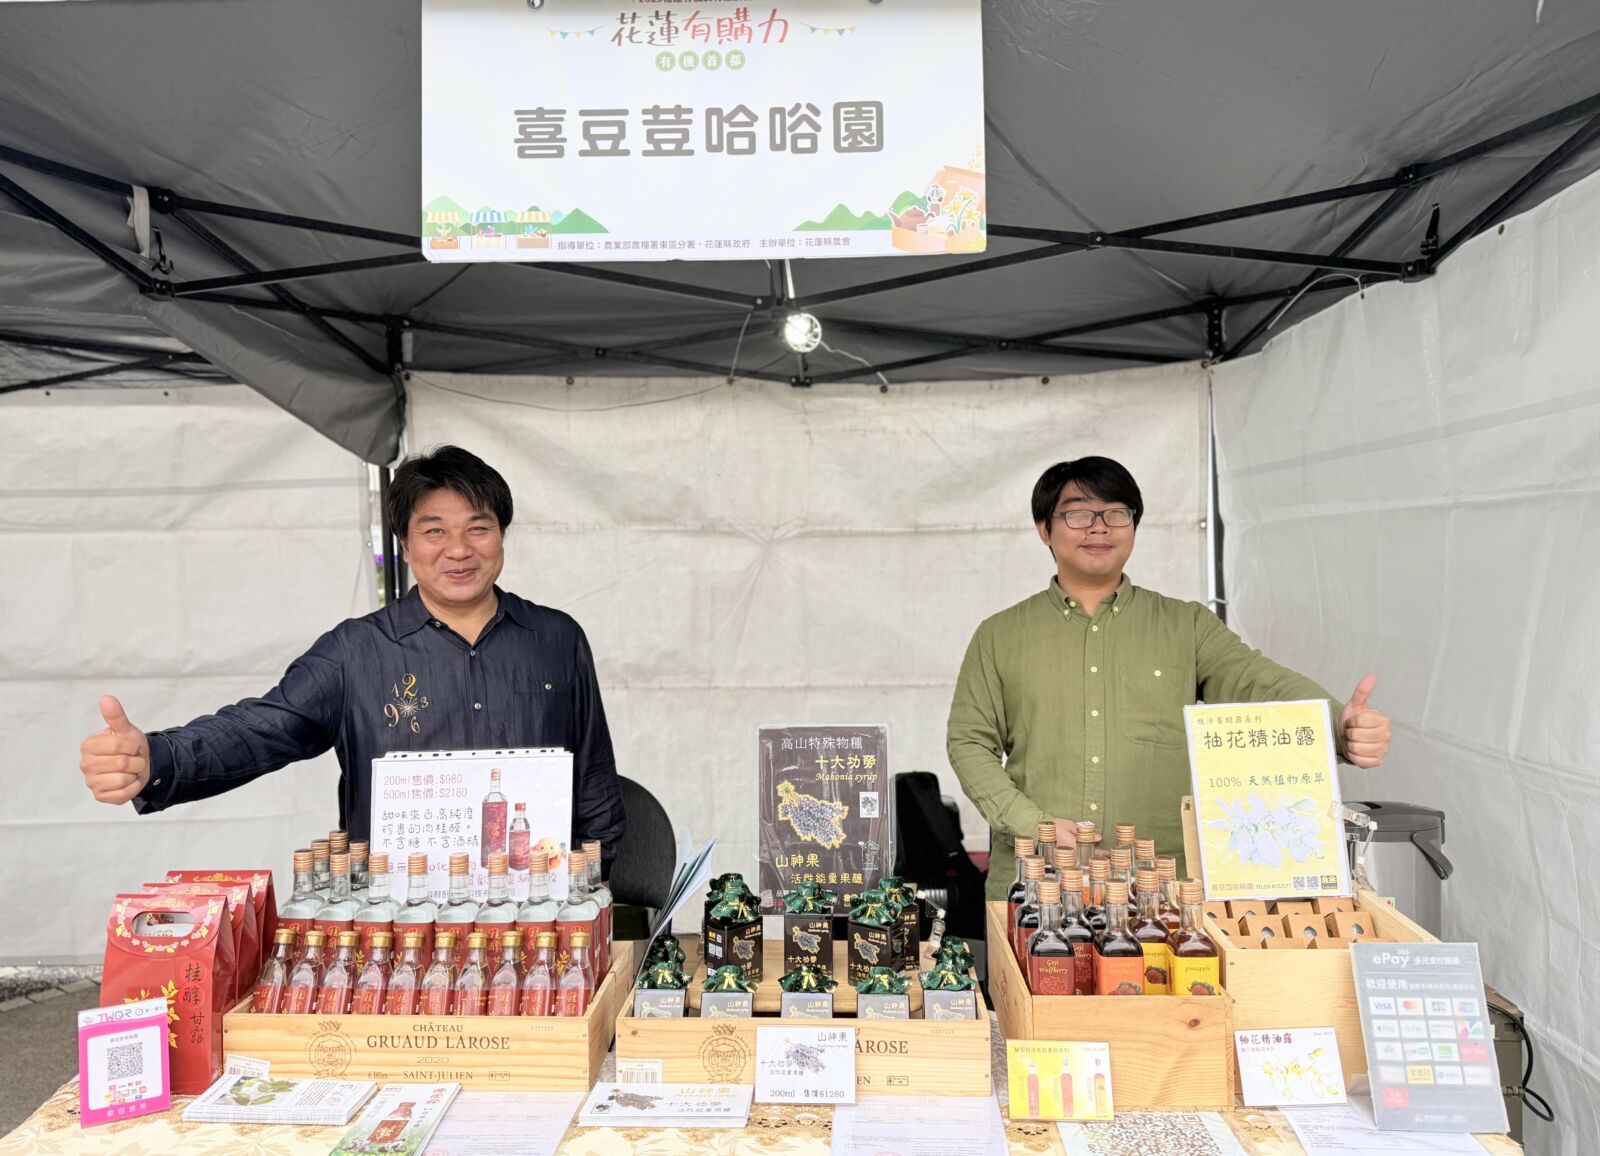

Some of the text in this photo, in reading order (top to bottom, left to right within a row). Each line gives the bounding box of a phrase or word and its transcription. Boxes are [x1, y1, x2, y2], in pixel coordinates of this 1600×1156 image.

[610, 6, 789, 47] 花蓮有購力
[658, 53, 743, 69] 有機首都
[781, 736, 863, 750] 高山特殊物種
[1203, 726, 1316, 749] 柚花精油露
[815, 754, 878, 770] 十大功勞
[815, 772, 878, 783] Mahonia syrup
[1208, 772, 1326, 788] 100% 天然植物原萃
[381, 806, 474, 822] 甜味來自高純度
[382, 834, 480, 850] 不含糖 不含酒精
[775, 853, 820, 868] 山神果
[808, 921, 829, 929] 山神果
[867, 931, 887, 941] 山神果
[1373, 952, 1411, 968] ePay
[1184, 965, 1212, 973] pineapple
[1374, 1002, 1392, 1010] VISA
[412, 1021, 464, 1032] CHÂTEAU
[366, 1034, 438, 1049] GRUAUD
[445, 1035, 510, 1050] LAROSE
[817, 1031, 848, 1042] 山神果
[1239, 1032, 1293, 1045] 柚花精油露
[855, 1040, 909, 1054] AROSE
[416, 1056, 450, 1064] 2020
[402, 1070, 474, 1081] SAINT-JULIEN
[769, 1089, 796, 1098] 200ml
